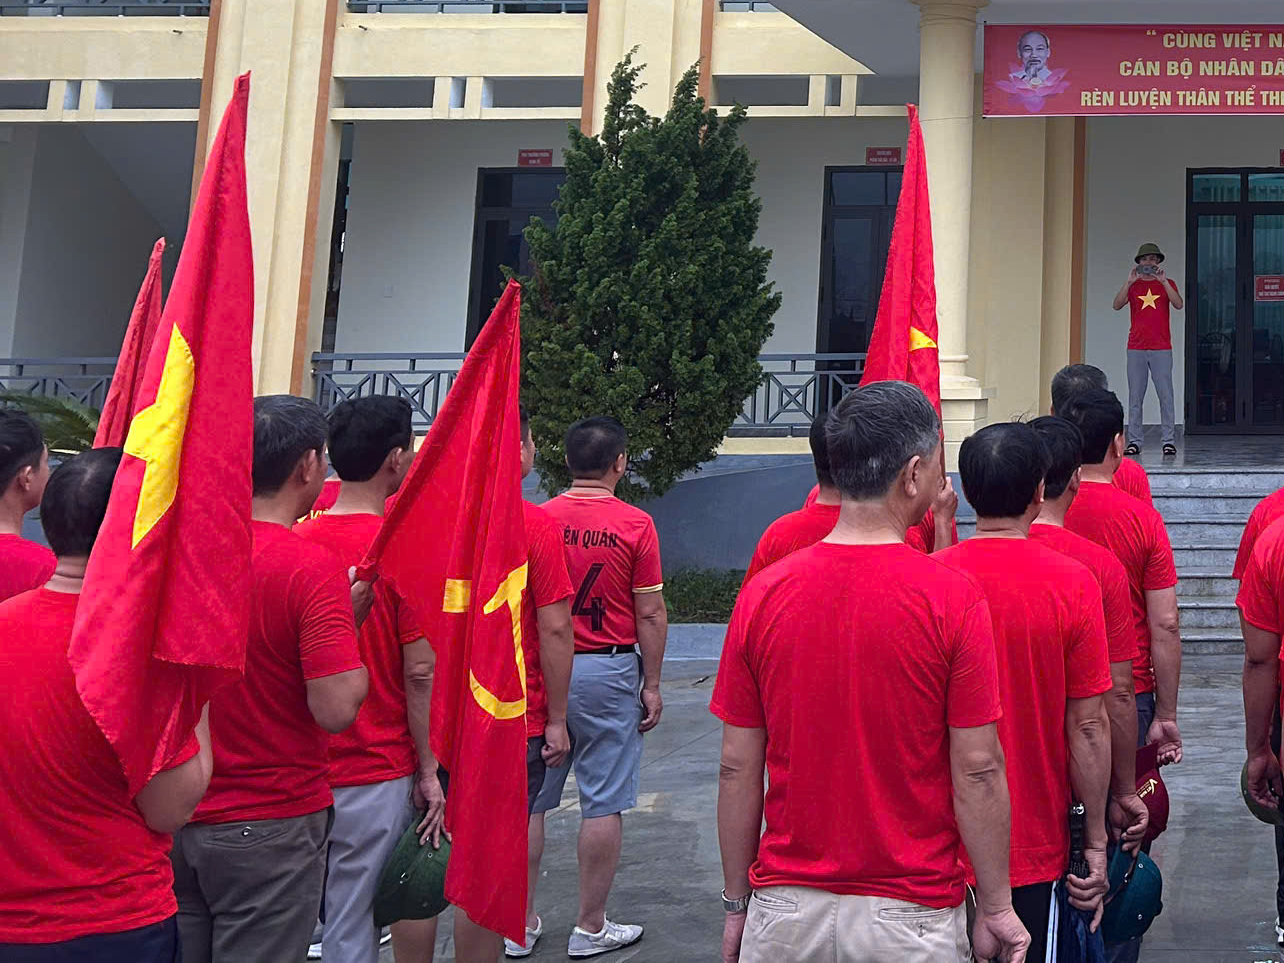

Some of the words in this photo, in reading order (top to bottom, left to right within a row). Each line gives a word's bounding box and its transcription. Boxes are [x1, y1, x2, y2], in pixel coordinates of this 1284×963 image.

[1162, 30, 1217, 49] CÙNG
[1222, 30, 1263, 52] VIỆT
[1119, 57, 1161, 77] CÁN
[1166, 57, 1193, 80] BỘ
[1199, 57, 1255, 76] NHÂN
[1080, 87, 1115, 107] RÈN
[1119, 87, 1172, 110] LUYỆN
[1175, 87, 1220, 106] THÂN
[1224, 84, 1257, 106] THỂ
[571, 562, 607, 632] 4
